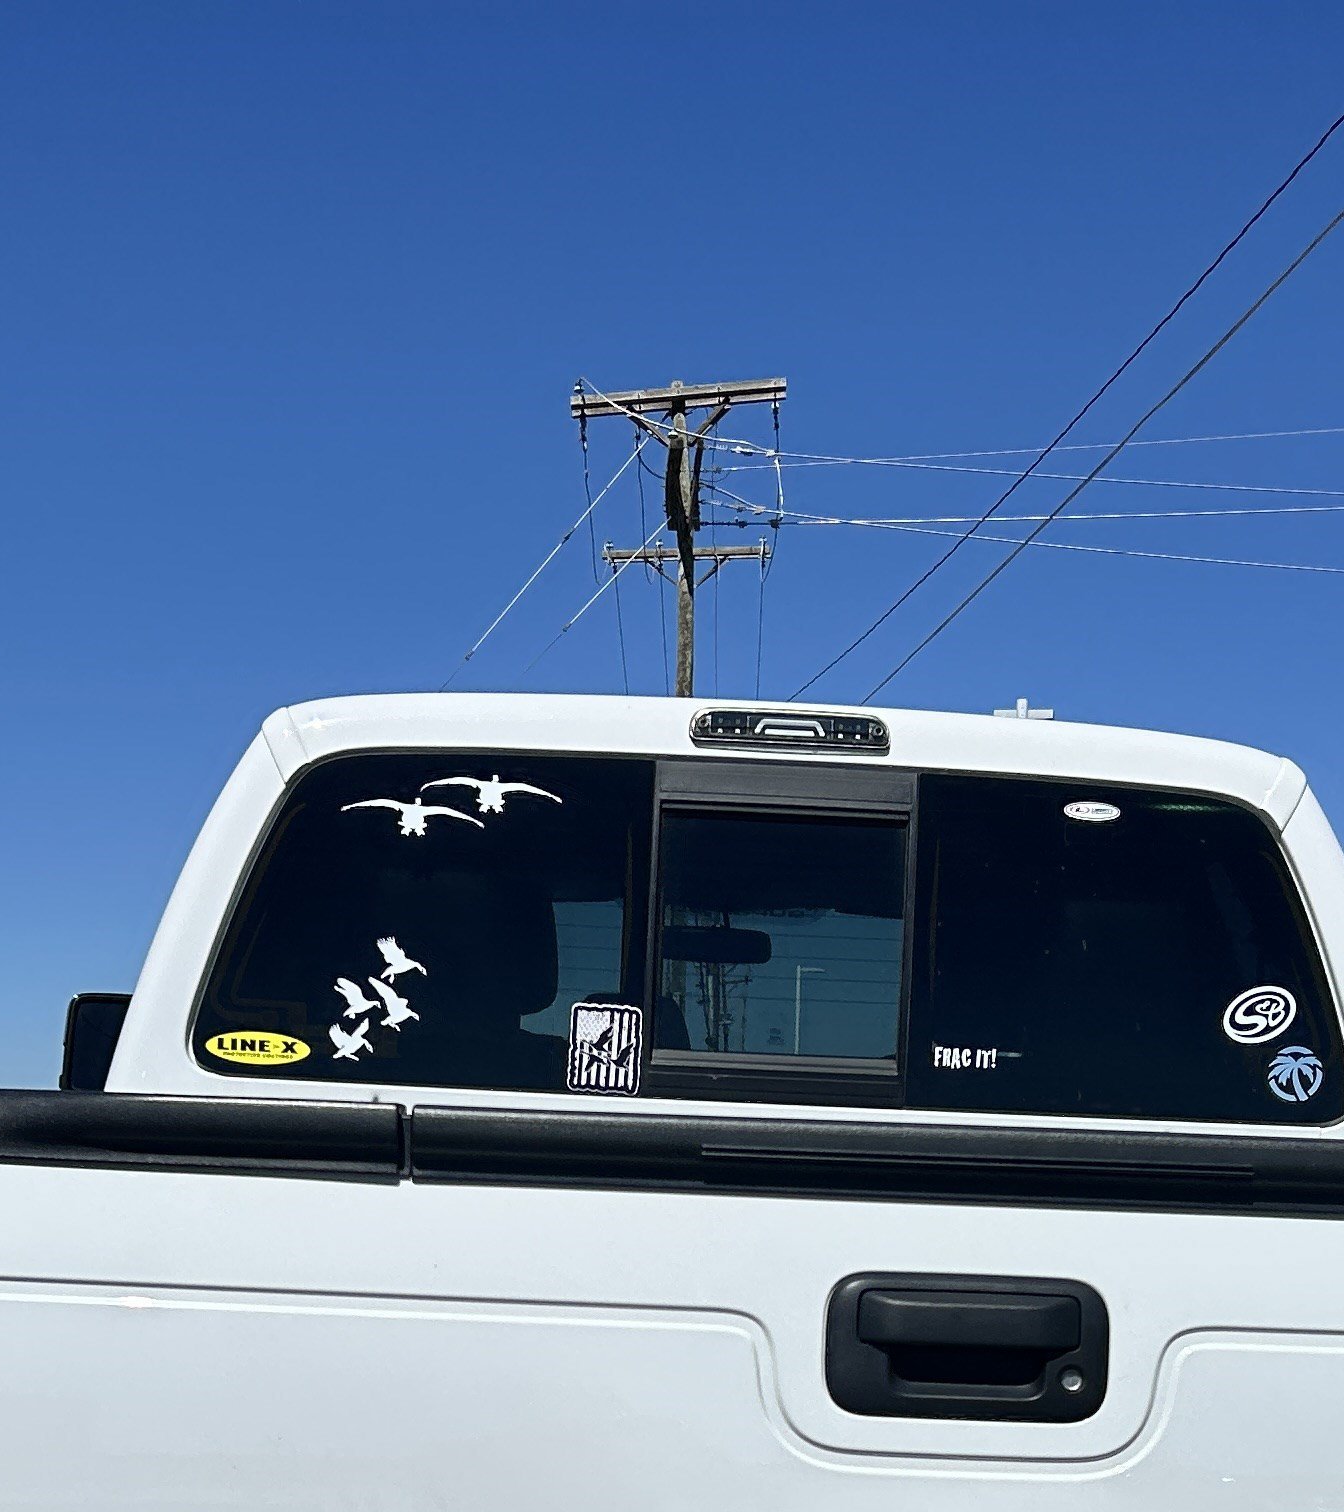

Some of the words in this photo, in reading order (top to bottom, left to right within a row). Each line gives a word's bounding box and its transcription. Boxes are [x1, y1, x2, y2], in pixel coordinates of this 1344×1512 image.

[217, 1037, 298, 1055] LINE-X
[933, 1046, 972, 1069] FRAC
[975, 1048, 997, 1069] IT!
